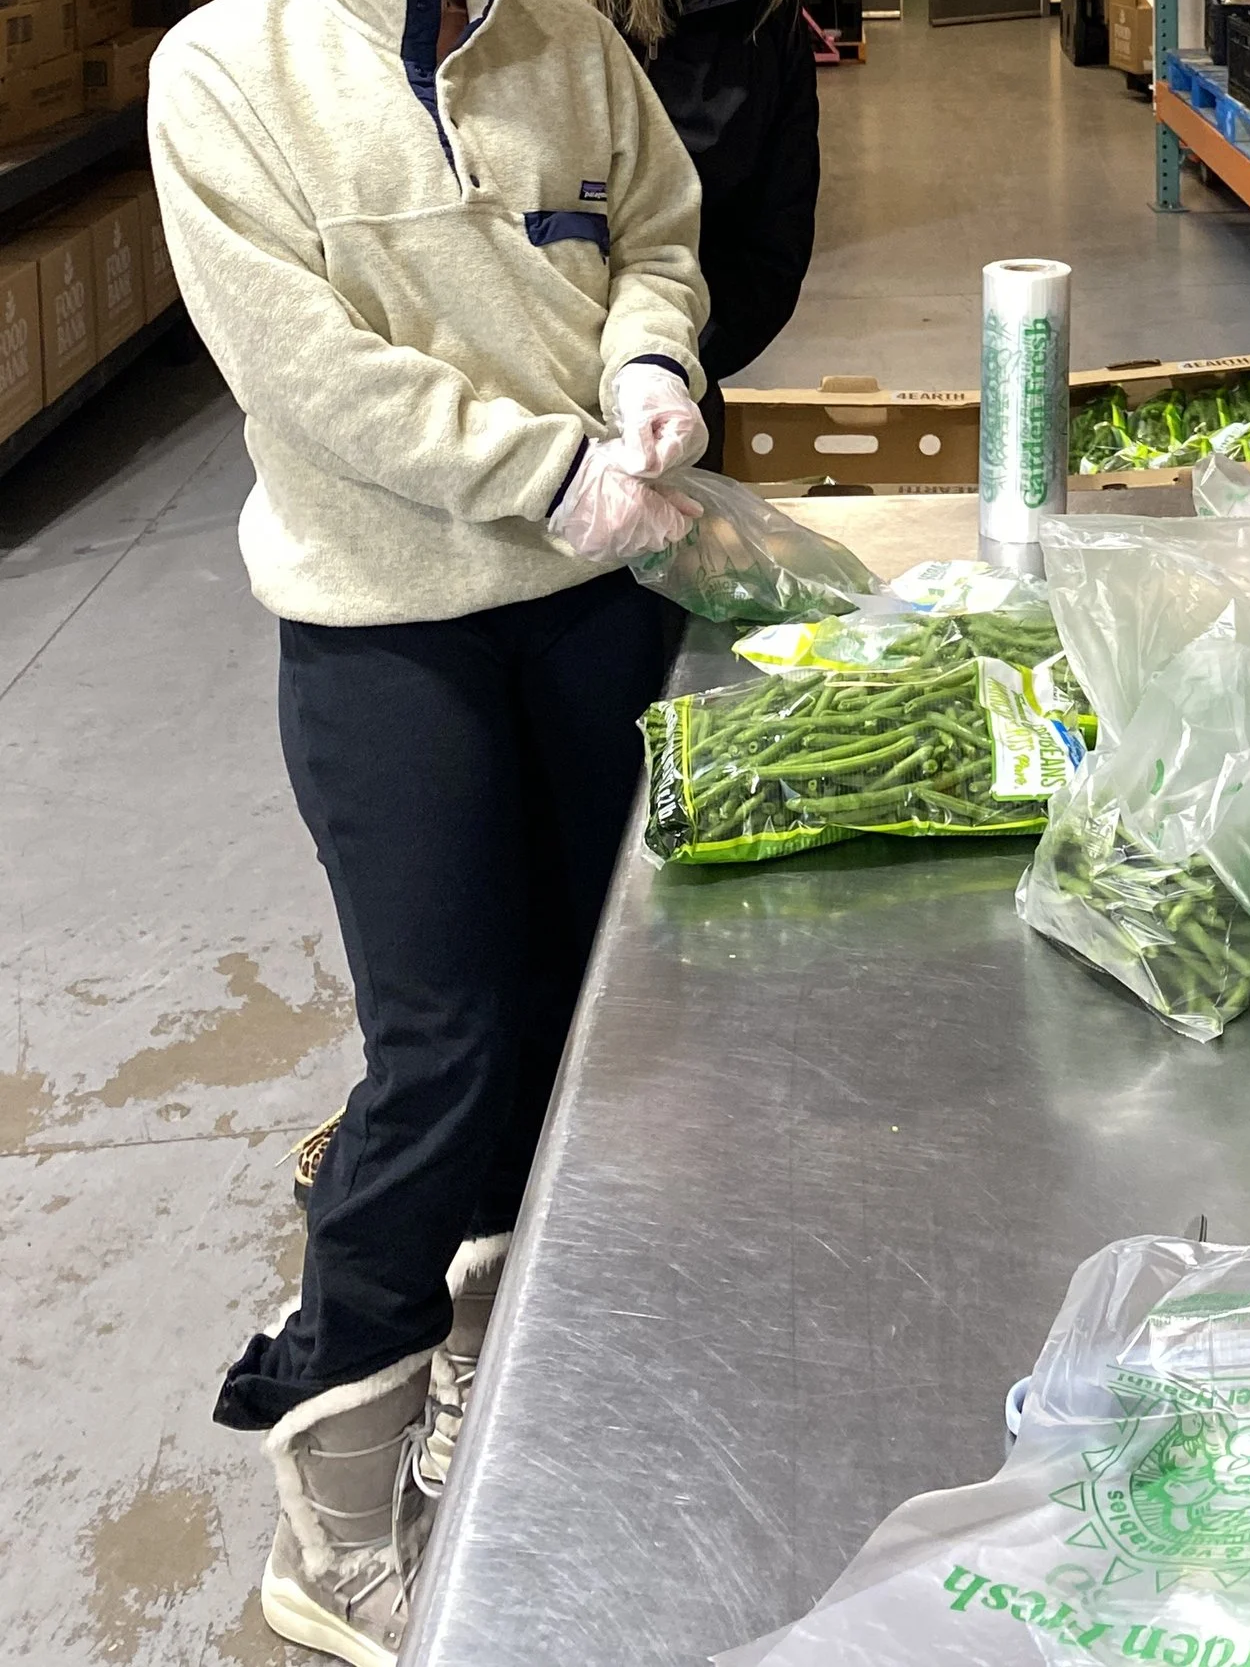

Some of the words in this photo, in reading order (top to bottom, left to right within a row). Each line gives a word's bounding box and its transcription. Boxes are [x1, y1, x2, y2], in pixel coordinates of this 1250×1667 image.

[1024, 316, 1052, 396] Fresh
[1181, 356, 1250, 370] 4EARTH
[896, 391, 966, 402] 4EARTH
[1022, 406, 1048, 510] Garden
[943, 1565, 1115, 1650] Fresh
